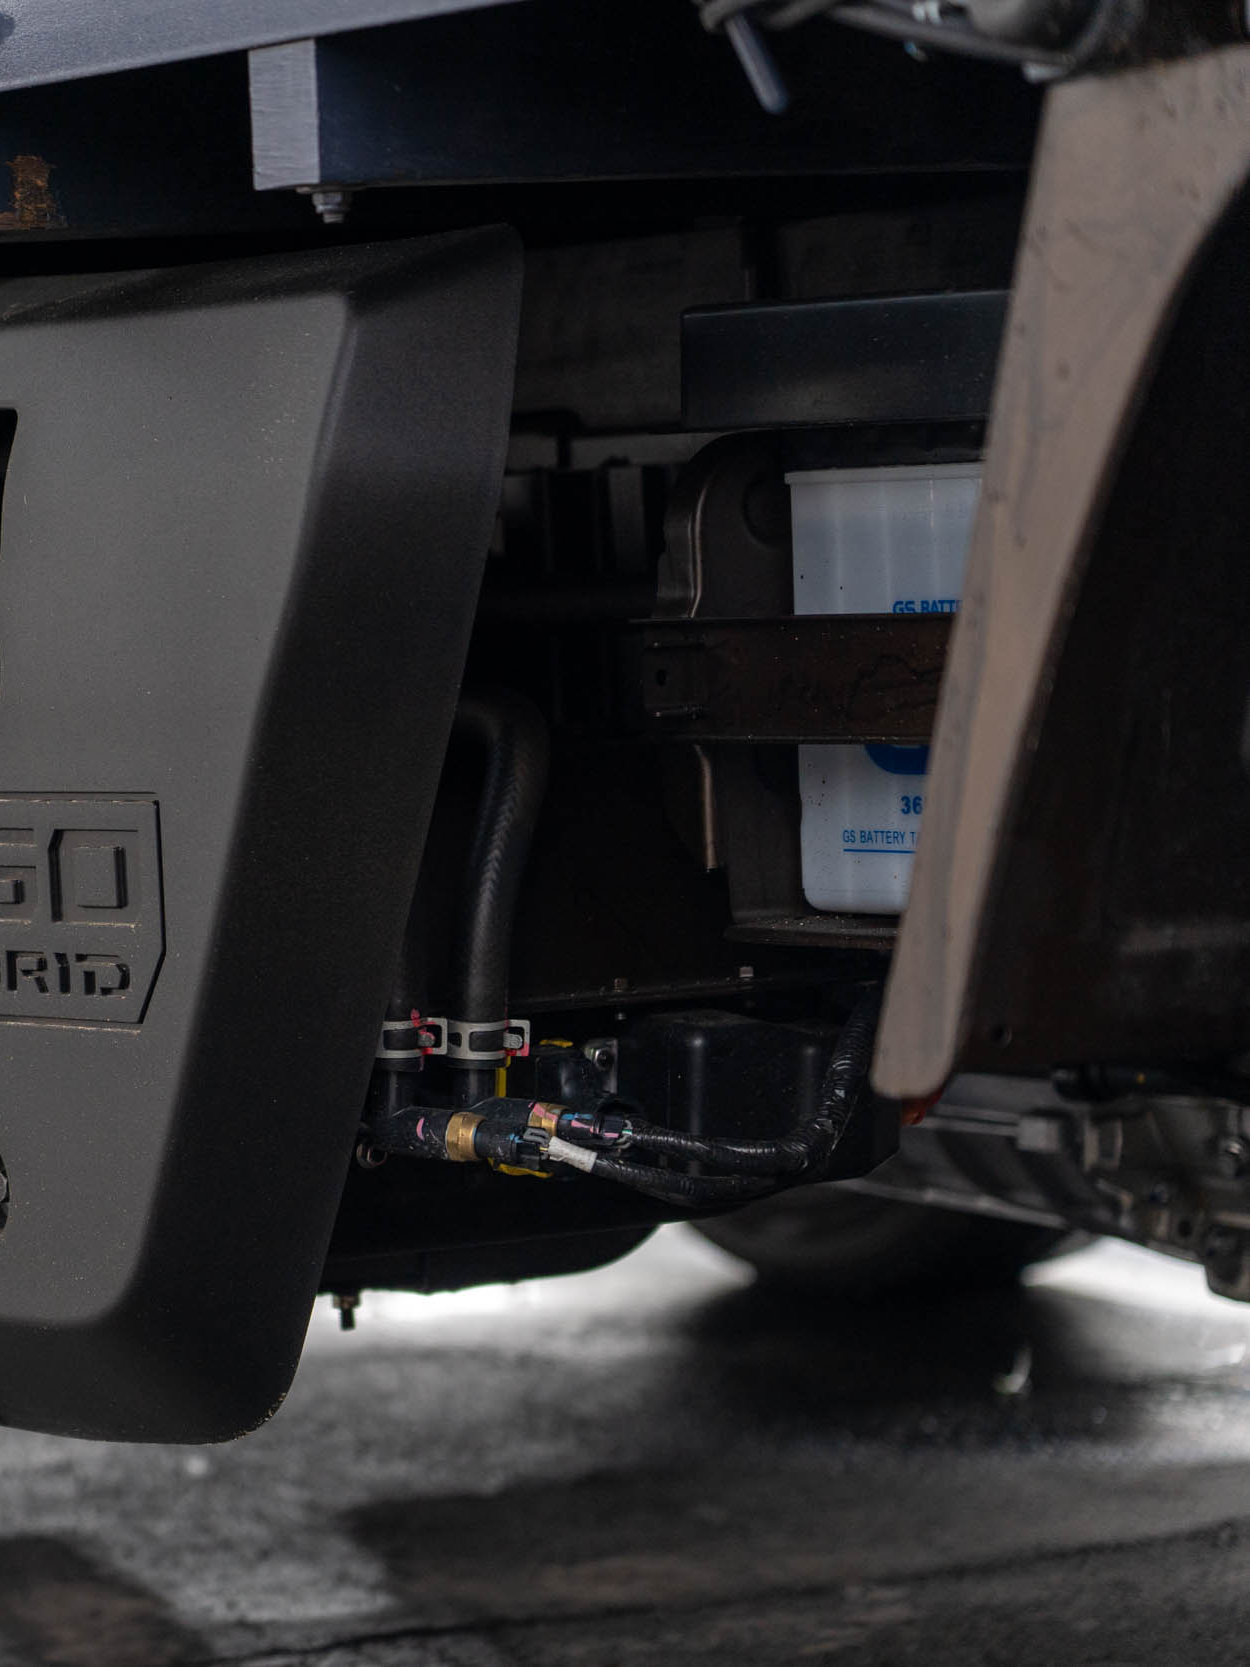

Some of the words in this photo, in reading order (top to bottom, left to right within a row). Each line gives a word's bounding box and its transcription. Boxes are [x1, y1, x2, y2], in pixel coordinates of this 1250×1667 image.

[892, 600, 916, 614] GS
[842, 830, 856, 843] GS
[860, 830, 905, 844] BATTERY
